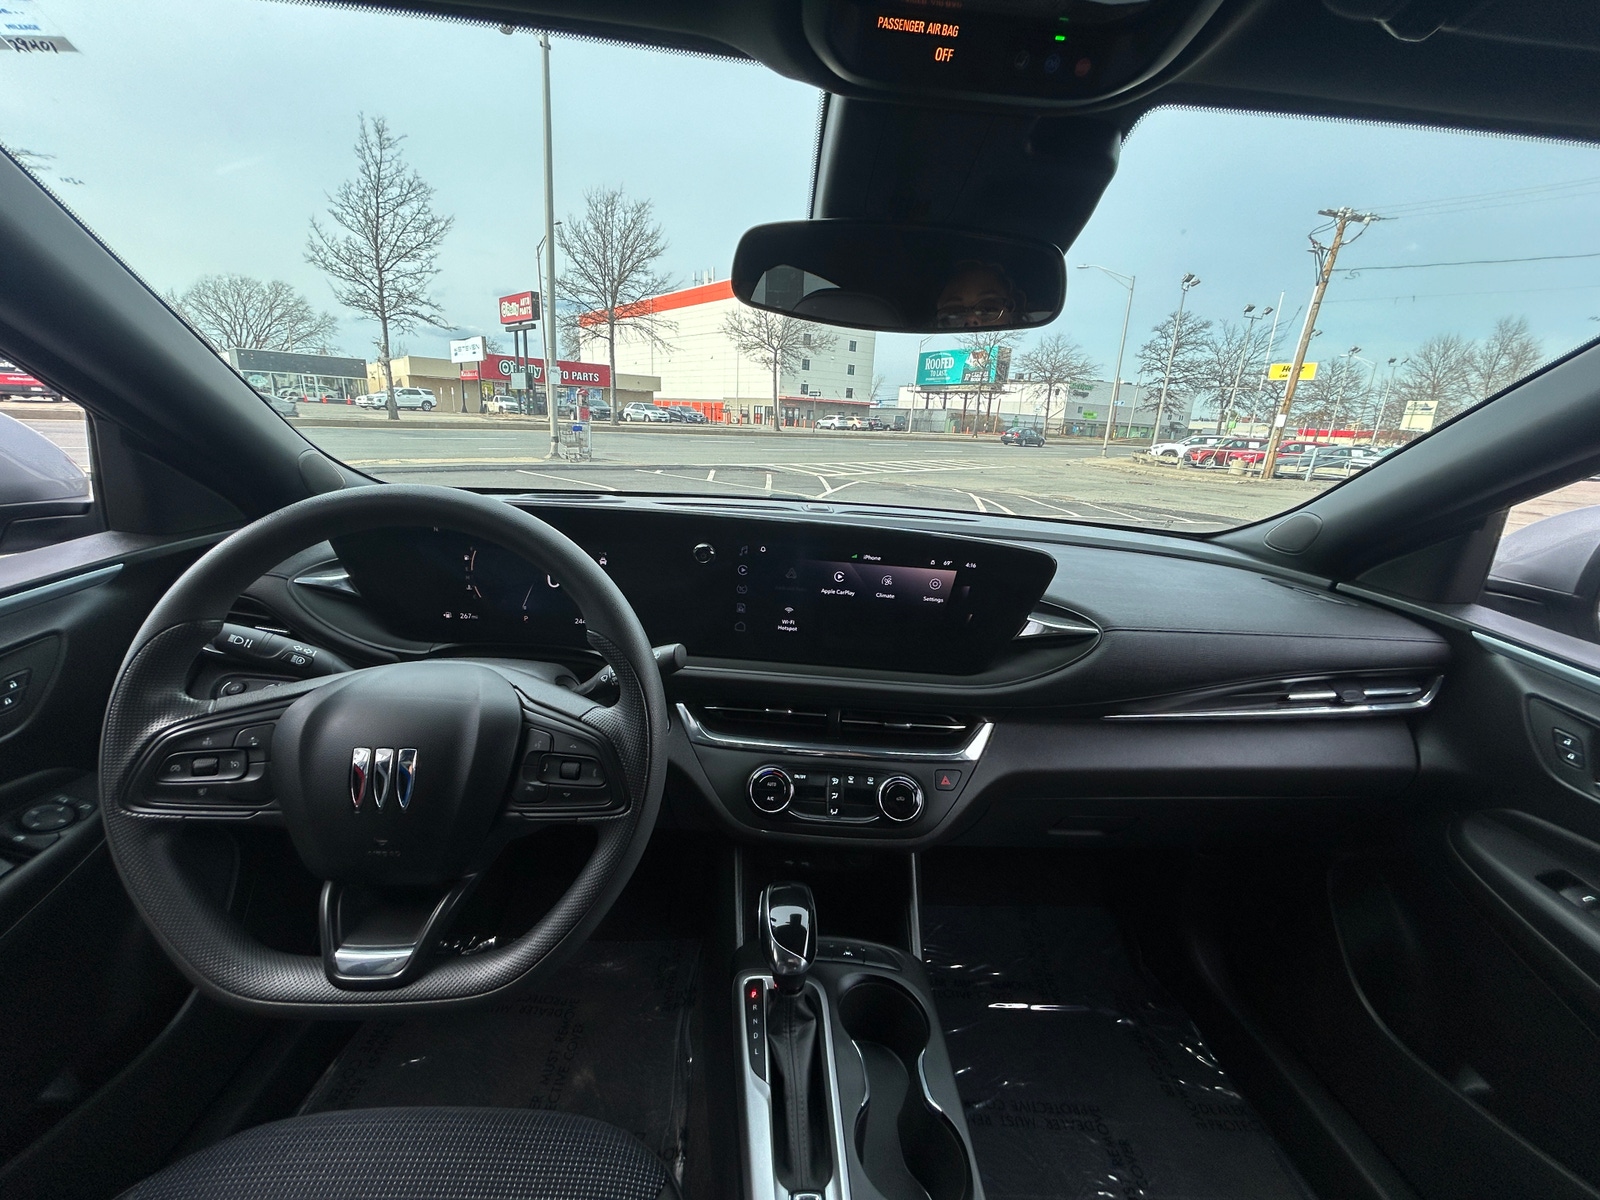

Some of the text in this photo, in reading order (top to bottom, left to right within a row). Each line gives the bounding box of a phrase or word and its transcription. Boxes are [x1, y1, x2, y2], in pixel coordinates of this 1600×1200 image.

[877, 16, 959, 38] PASSENGER AIR BAG
[934, 47, 954, 63] OFF
[925, 357, 954, 370] ROOFED
[571, 371, 599, 382] PARTS
[863, 554, 881, 562] iPhone
[836, 589, 855, 597] CarPlay
[923, 595, 944, 604] Settings
